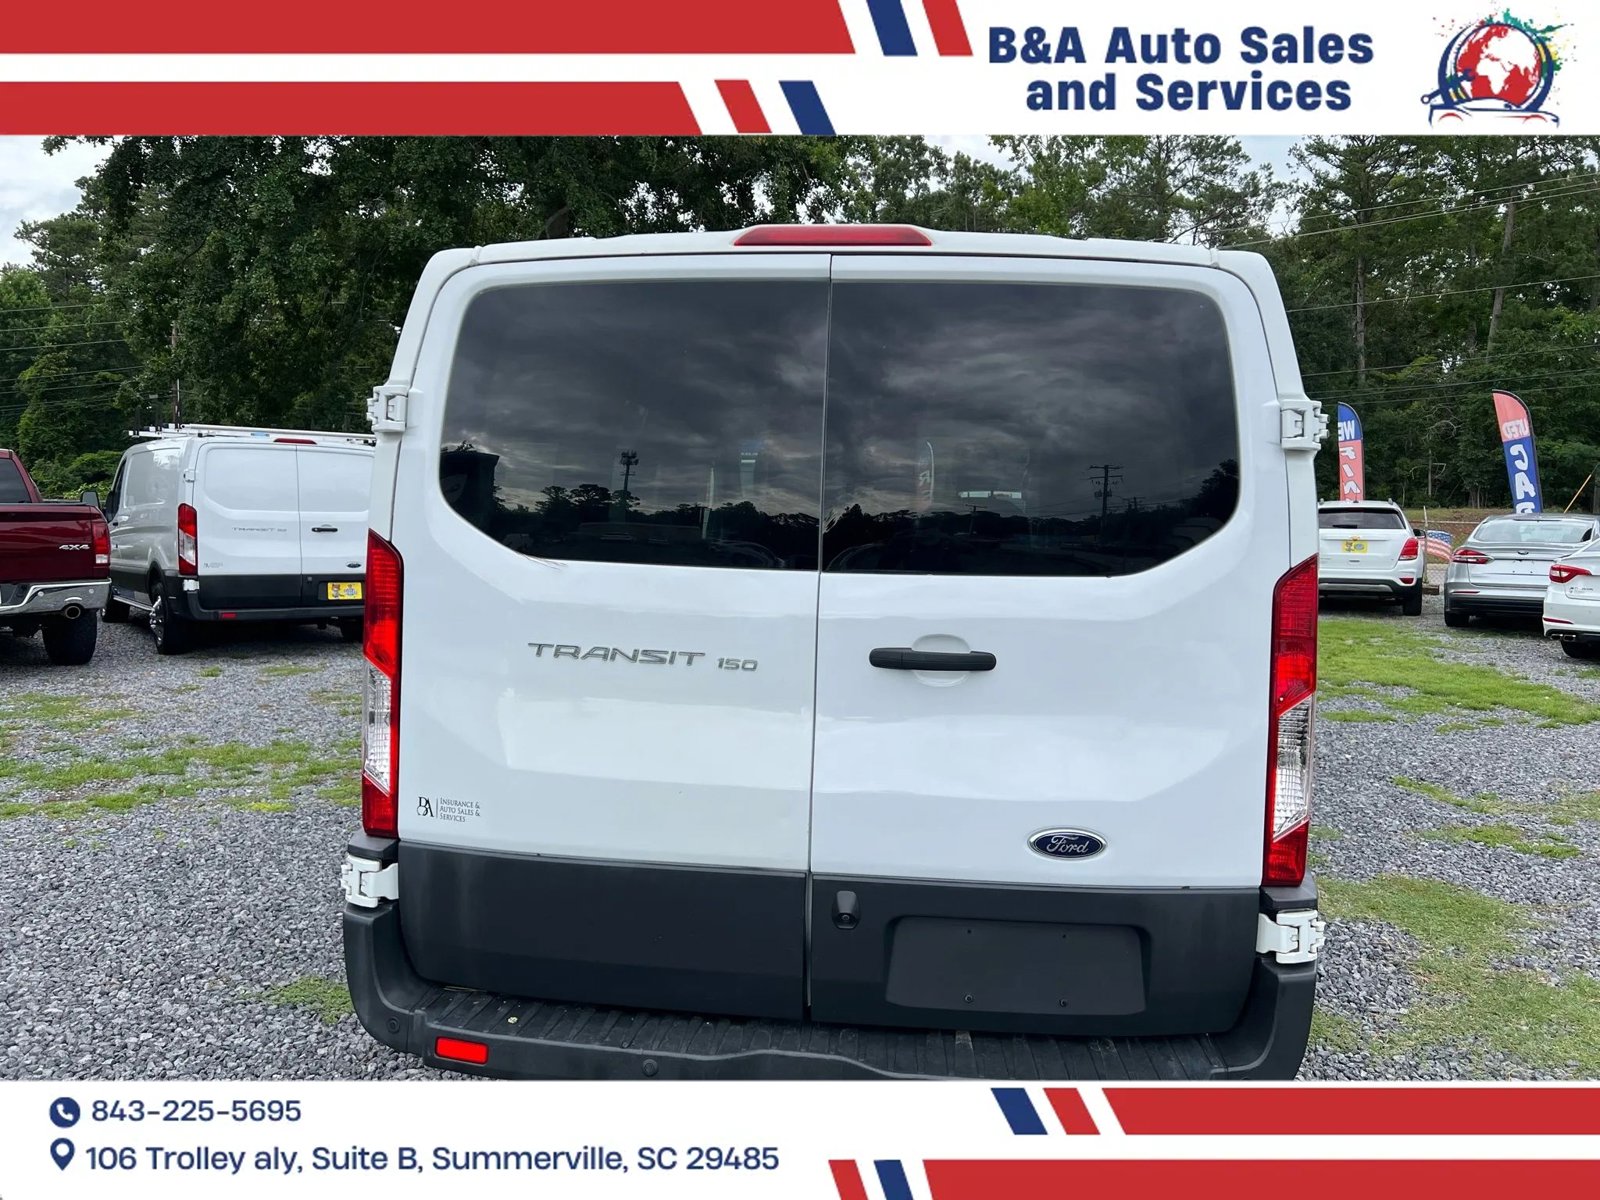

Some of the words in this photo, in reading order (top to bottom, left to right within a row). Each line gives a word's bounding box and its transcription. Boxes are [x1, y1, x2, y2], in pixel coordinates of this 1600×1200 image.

[528, 642, 706, 667] TRANSIT
[716, 656, 758, 672] 150
[1046, 835, 1090, 853] Ford
